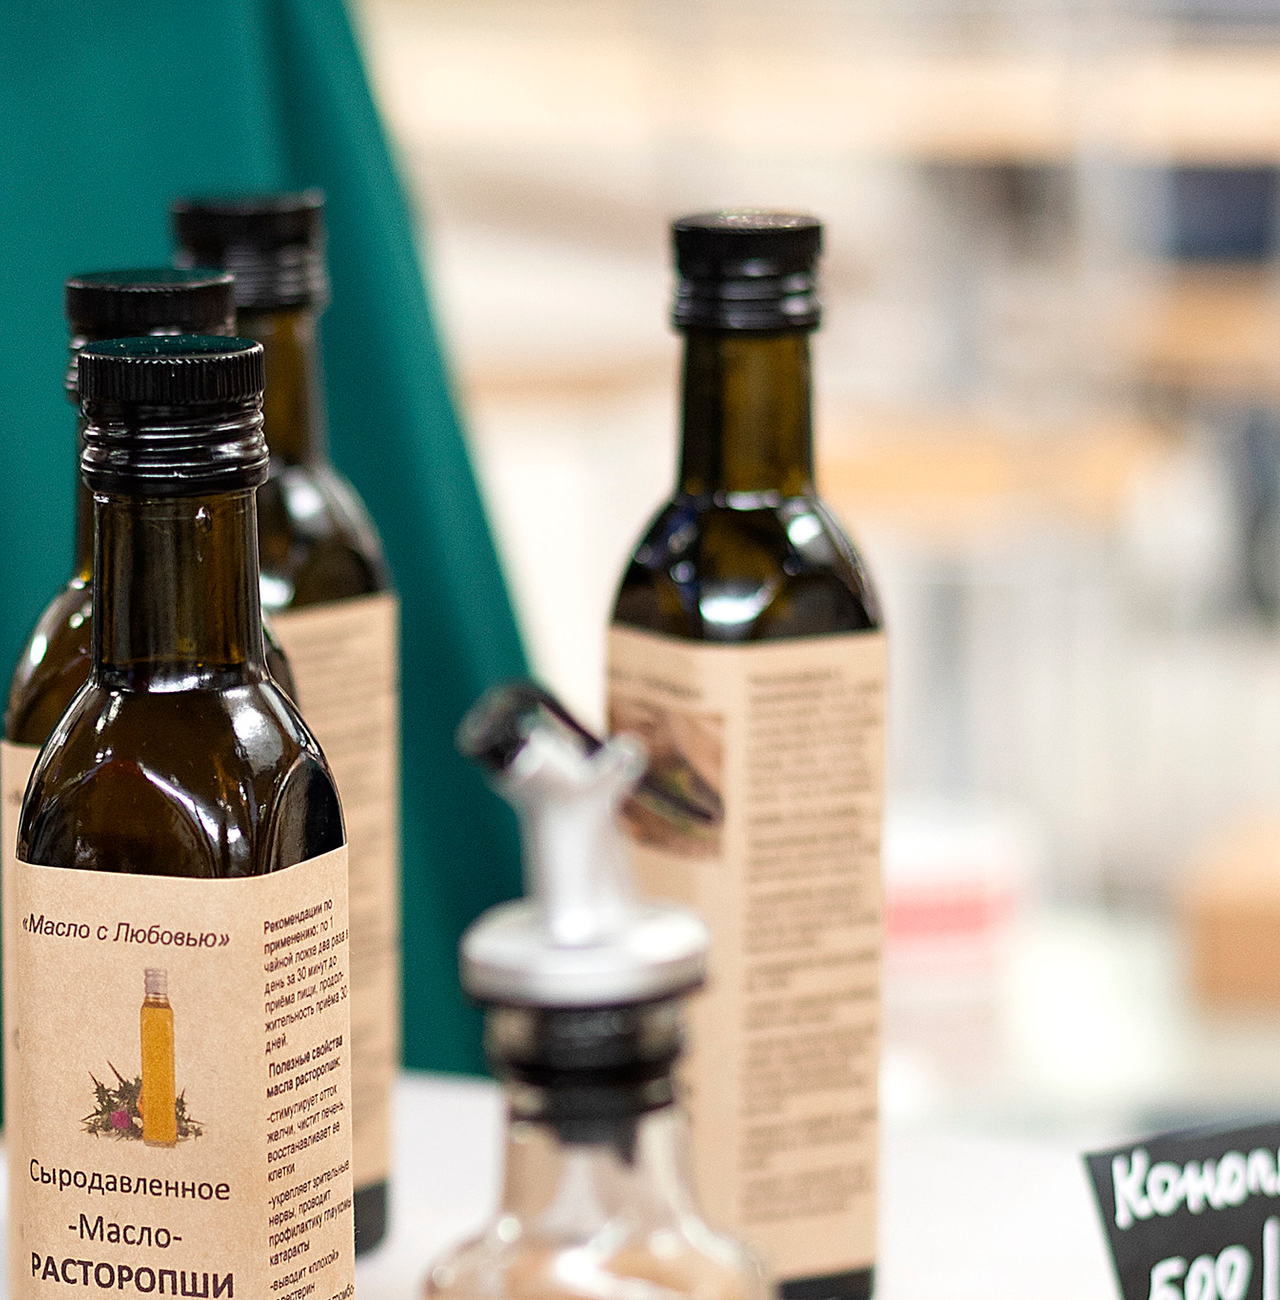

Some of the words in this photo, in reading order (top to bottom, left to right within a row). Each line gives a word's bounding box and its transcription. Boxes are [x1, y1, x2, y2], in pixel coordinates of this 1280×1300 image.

[22, 913, 90, 939] «Масло
[96, 924, 108, 941] с
[113, 922, 230, 949] Любовью»
[264, 903, 322, 934] Рекомендации
[324, 899, 333, 912] по
[264, 924, 319, 956] применению:
[320, 920, 328, 933] по
[264, 952, 294, 974] чайной
[318, 940, 330, 955] два
[264, 978, 285, 996] день
[287, 973, 296, 986] за
[297, 966, 306, 980] 30
[328, 955, 337, 969] до
[265, 993, 295, 1014] приёма
[265, 1005, 314, 1033] жительность
[269, 1051, 310, 1078] Полезные
[312, 1035, 343, 1060] свойства
[266, 1079, 294, 1099] масла
[320, 1084, 338, 1102] отток
[297, 1112, 320, 1130] чистит
[267, 1126, 332, 1163] восстанавливает
[29, 1158, 231, 1201] Сыродавленное
[268, 1163, 295, 1182] клетки
[313, 1160, 350, 1190] зрительные
[1111, 1146, 1280, 1231] Коноп
[299, 1189, 331, 1216] проводит
[68, 1213, 183, 1249] -Масло-
[269, 1213, 322, 1249] профилактику
[269, 1240, 310, 1267] катаракты
[31, 1251, 234, 1299] РАСТОРОПШИ
